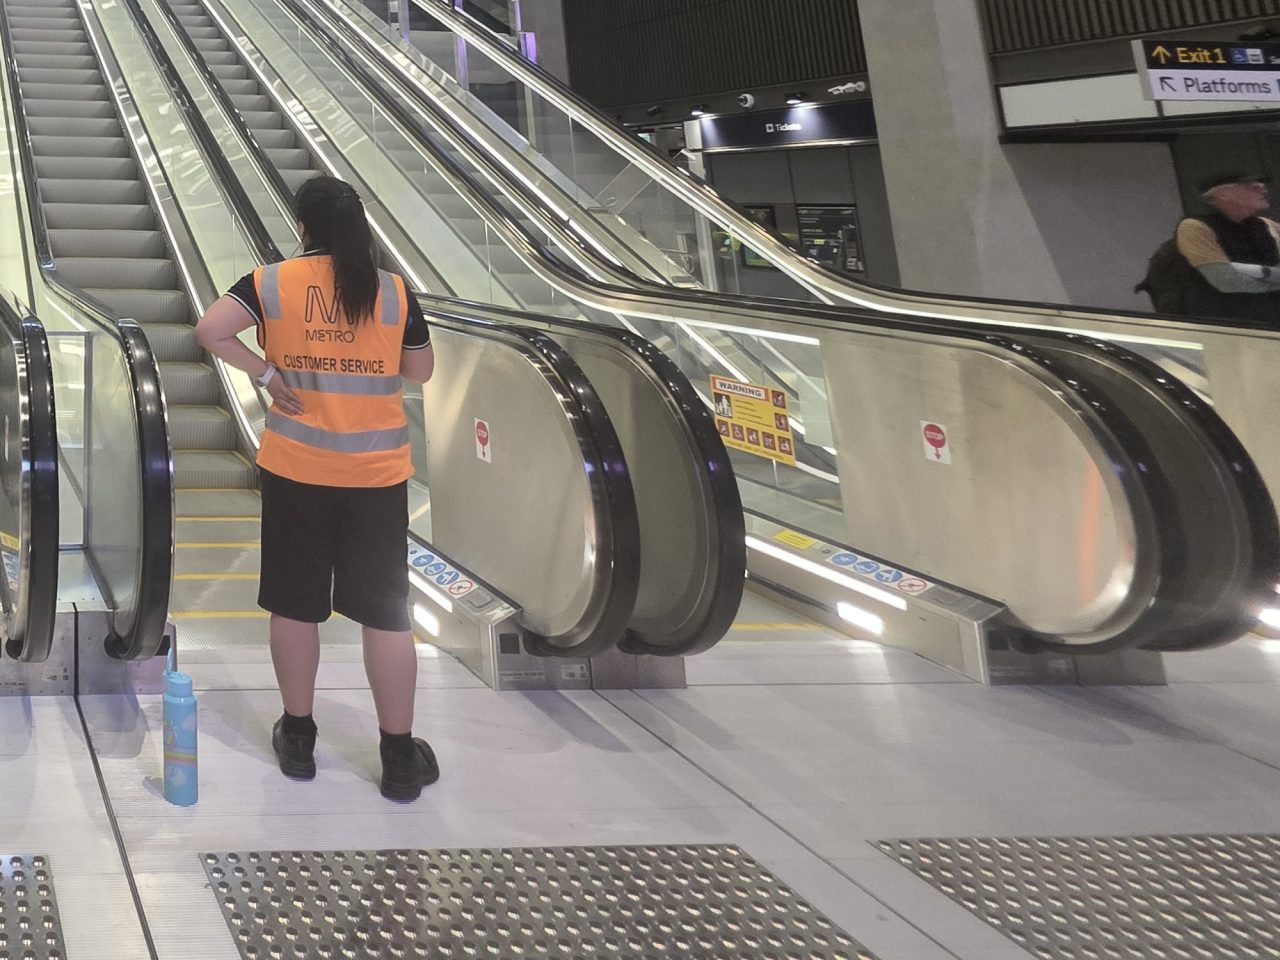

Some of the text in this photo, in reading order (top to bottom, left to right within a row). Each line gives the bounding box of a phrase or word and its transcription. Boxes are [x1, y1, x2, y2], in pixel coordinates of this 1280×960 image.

[1176, 47, 1227, 64] Exit 1
[1183, 77, 1272, 94] Platforms
[305, 329, 355, 344] METRO
[283, 354, 385, 375] CUSTOMER SERVICE
[719, 380, 762, 398] WARNING
